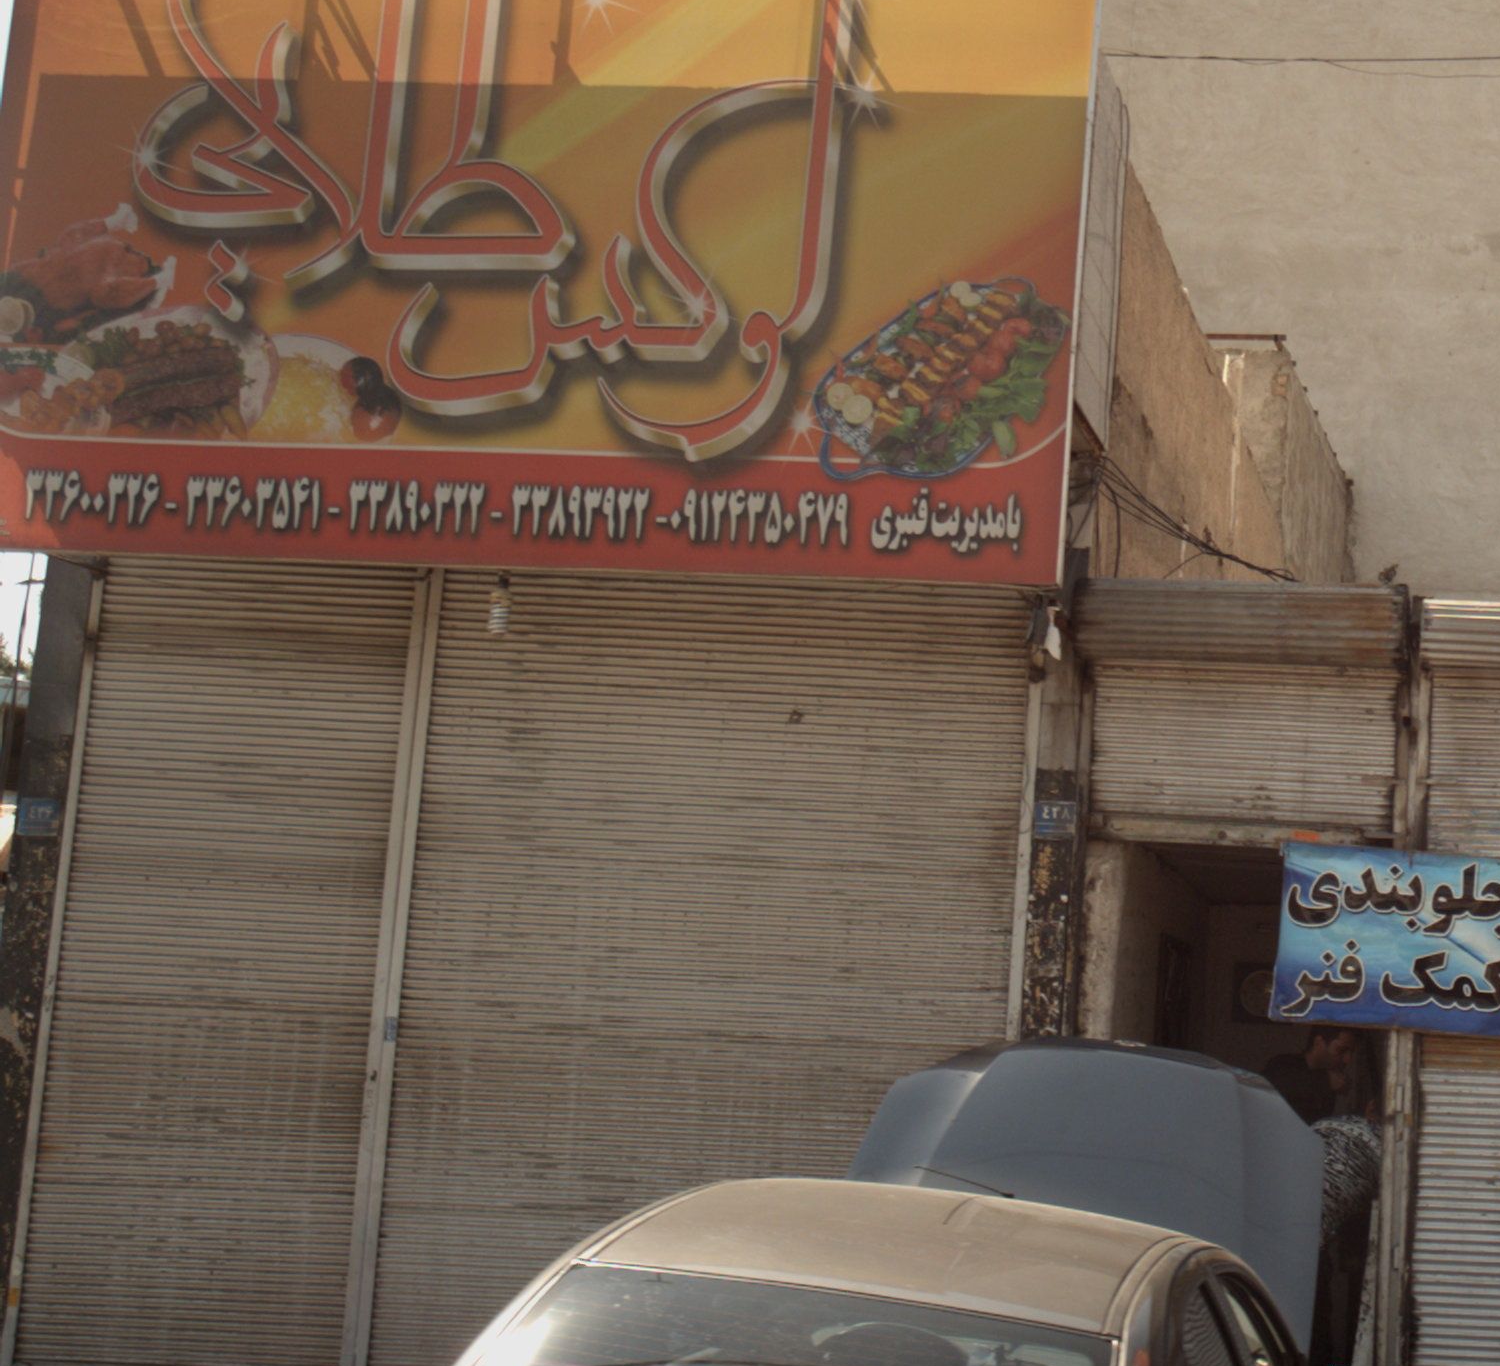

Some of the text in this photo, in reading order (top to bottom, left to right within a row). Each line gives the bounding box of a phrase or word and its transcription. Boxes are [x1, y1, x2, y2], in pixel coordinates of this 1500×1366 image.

[25, 469, 161, 526] ۳۳۶۰۰۳۲۶
[186, 475, 321, 530] ۳۳۶۰۳۵۴۱
[349, 478, 486, 535] ۳۳۸۹۰۳۲۲
[512, 483, 650, 539] ۳۳۸۹۳۹۲۲
[871, 487, 929, 550] قنبری
[1280, 938, 1366, 1018] فنر
